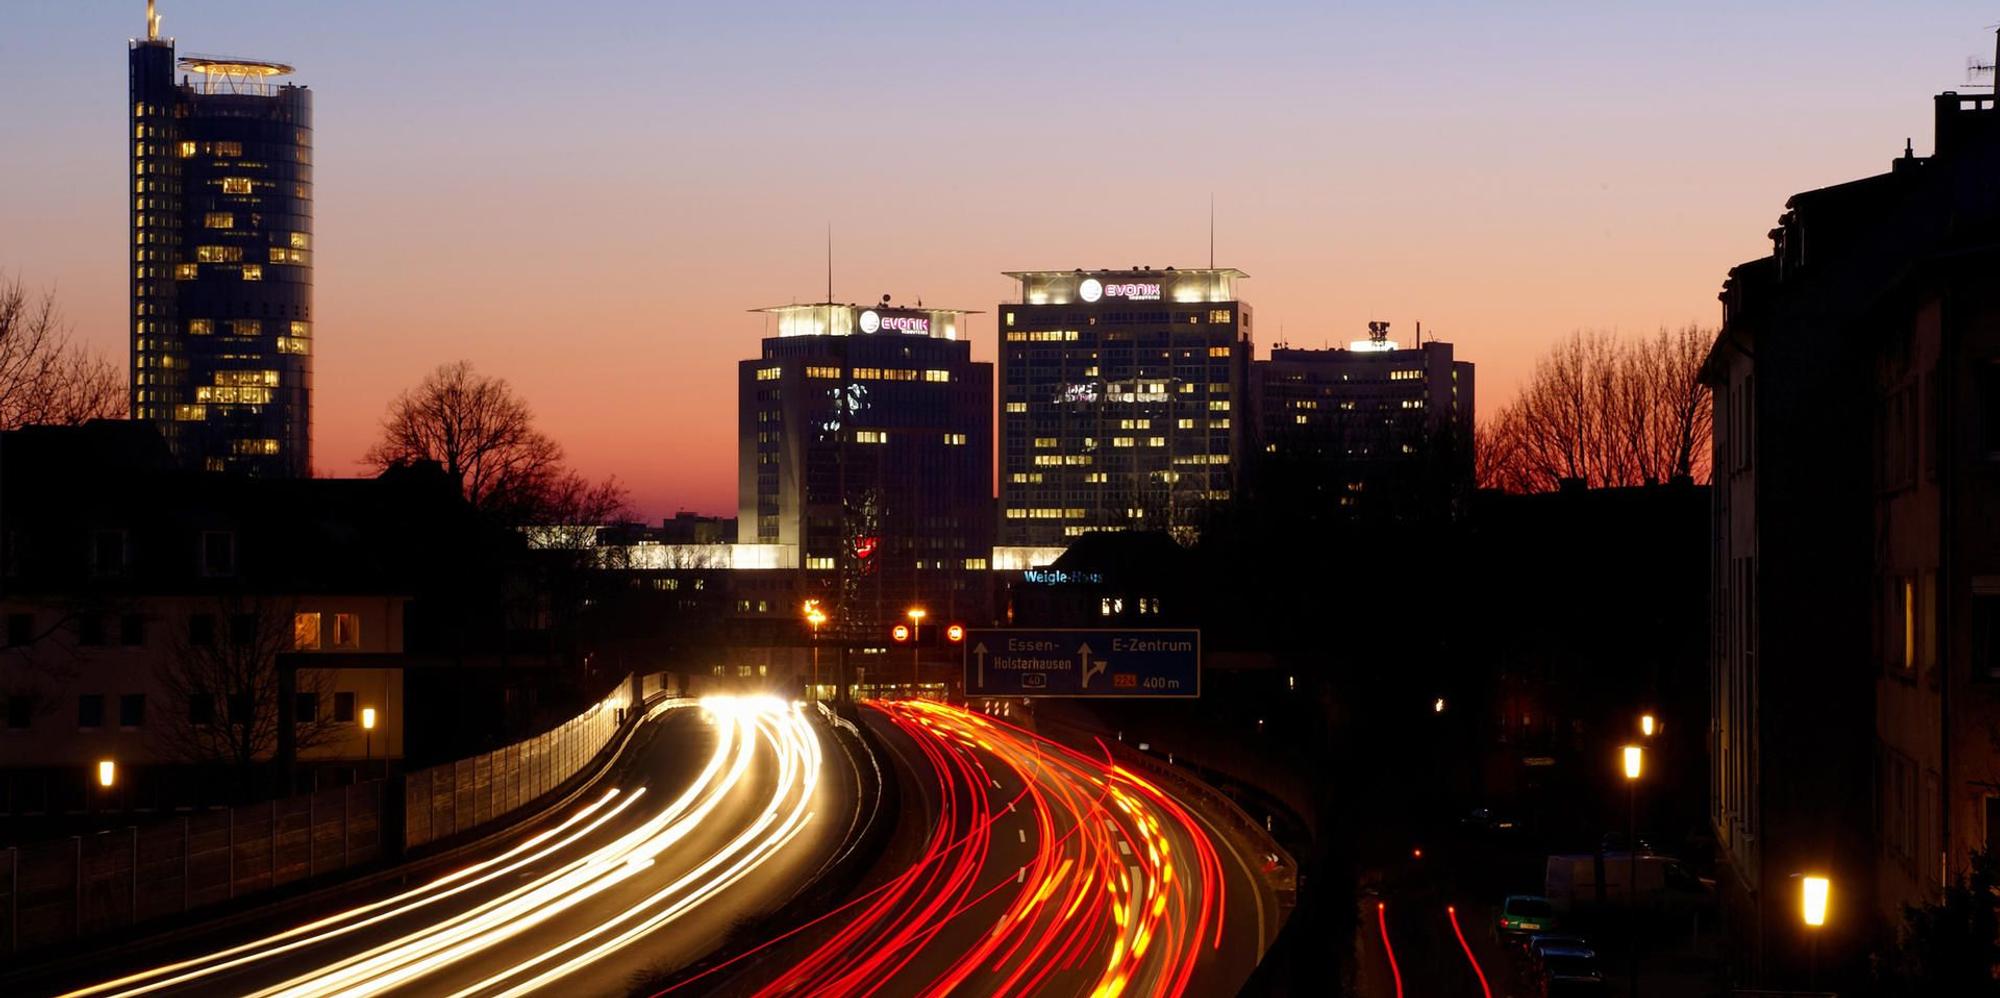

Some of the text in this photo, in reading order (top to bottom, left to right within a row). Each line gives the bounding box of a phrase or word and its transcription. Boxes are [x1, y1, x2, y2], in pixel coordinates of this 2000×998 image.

[881, 317, 929, 330] EVONIK
[1009, 638, 1060, 651] Essen-
[1112, 638, 1192, 652] E-Zentrum
[994, 656, 1071, 670] Holsterhausen
[1143, 676, 1180, 689] 400 m
